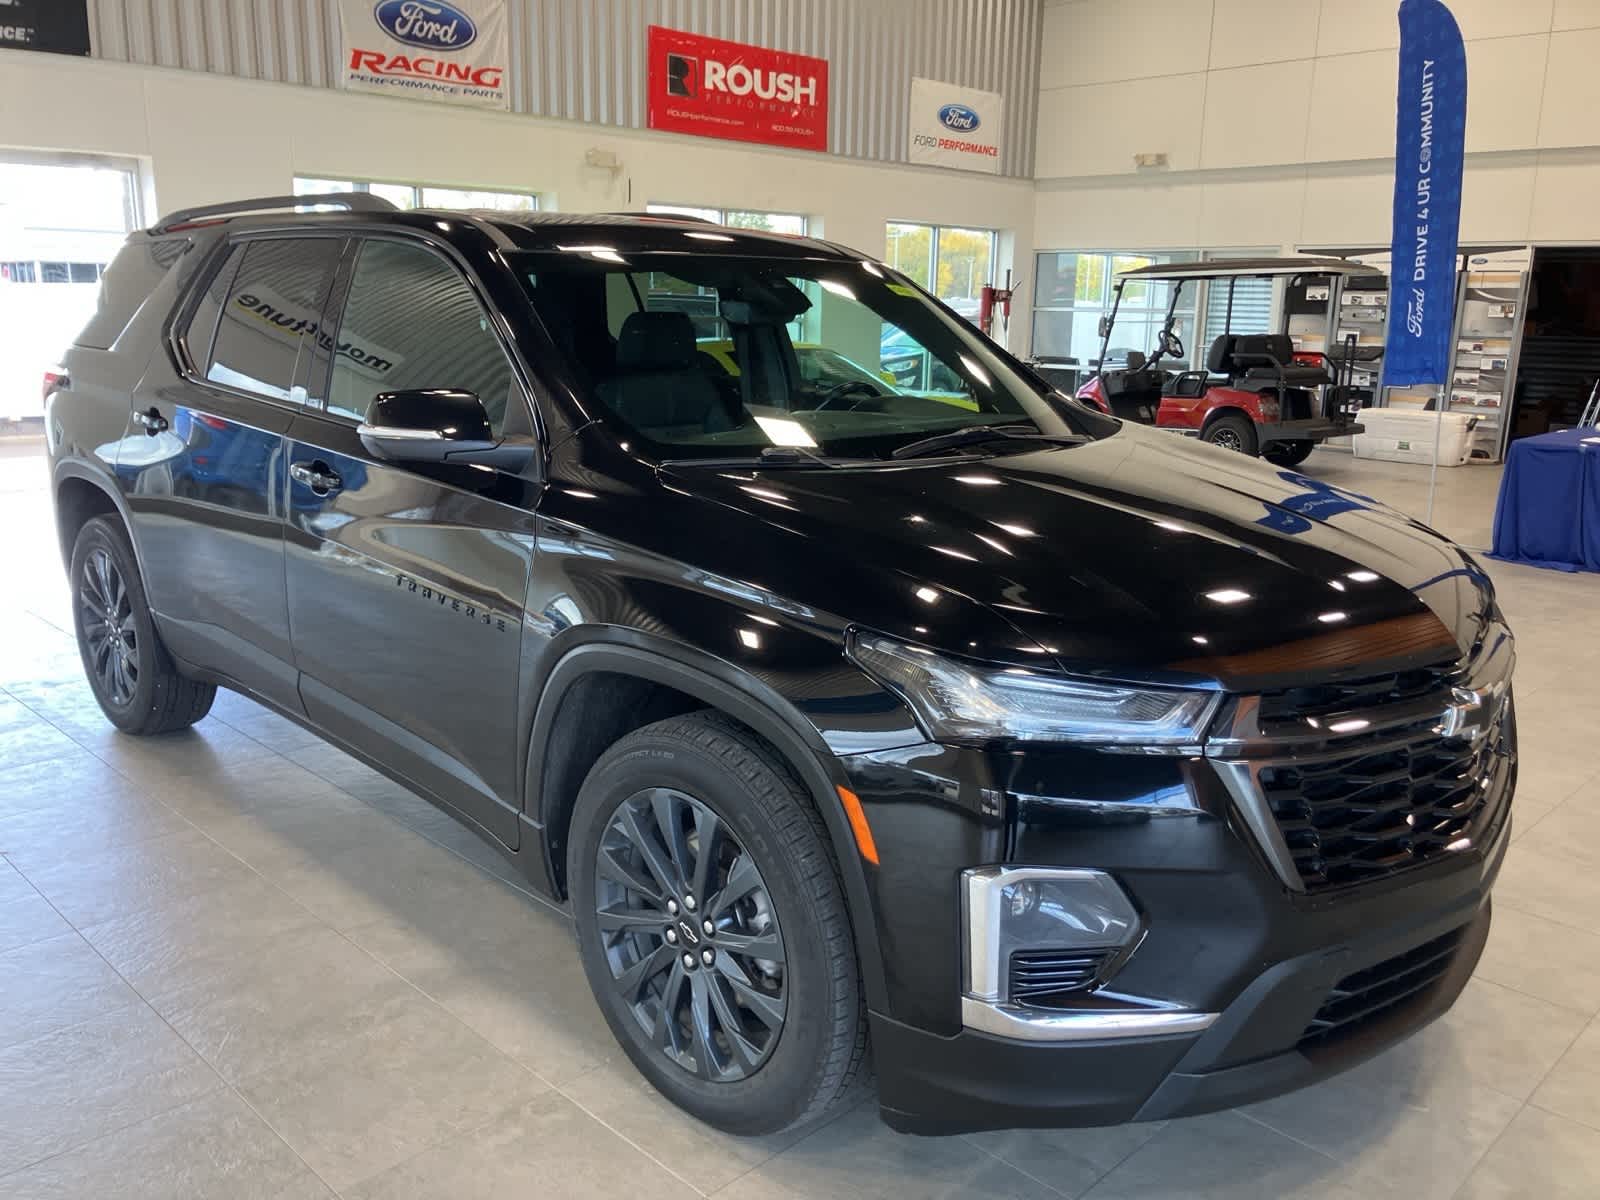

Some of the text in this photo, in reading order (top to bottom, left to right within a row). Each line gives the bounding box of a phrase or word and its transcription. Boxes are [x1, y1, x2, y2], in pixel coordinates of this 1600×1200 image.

[394, 1, 459, 44] Ford
[349, 74, 504, 100] PERFORMANCE PARTS
[350, 48, 504, 89] RACING
[704, 58, 817, 107] ROUSH
[945, 107, 974, 129] Ford
[914, 134, 999, 157] FORD PERFORMANCE
[1417, 177, 1432, 205] UR
[1416, 207, 1430, 220] 4
[1413, 224, 1429, 282] DRIVE
[1406, 287, 1426, 338] Ford
[395, 574, 506, 633] TRAVERSE
